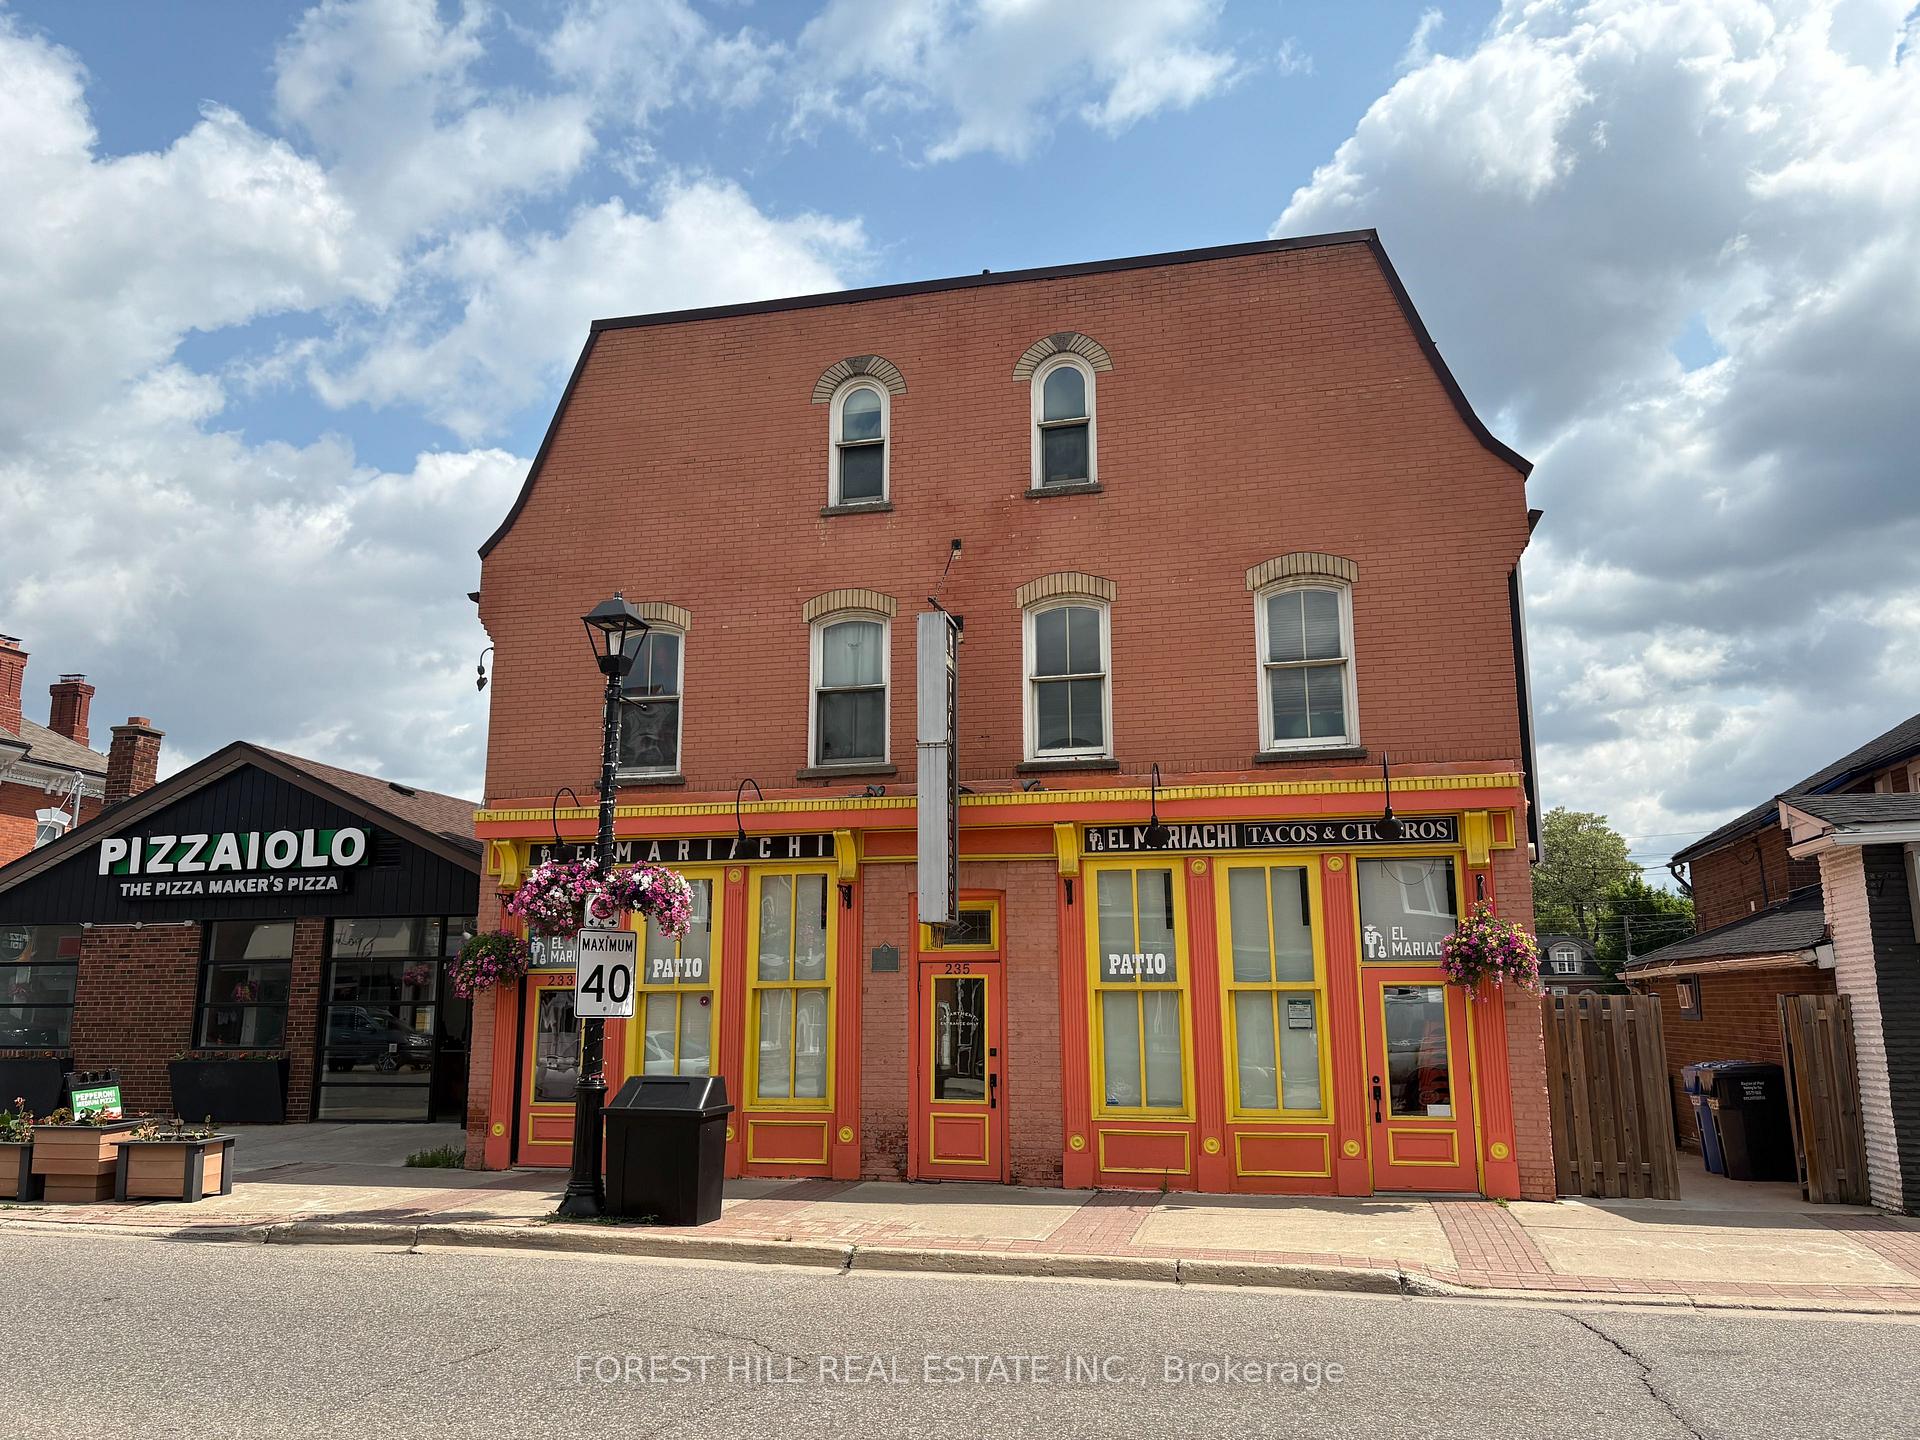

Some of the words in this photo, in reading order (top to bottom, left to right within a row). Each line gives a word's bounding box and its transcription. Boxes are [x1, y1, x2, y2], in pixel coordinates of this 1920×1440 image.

[1108, 828, 1130, 849] EL
[1133, 825, 1237, 849] MRIACHI
[1247, 825, 1317, 843] TACOS
[1323, 826, 1336, 840] &
[1341, 820, 1449, 841] CHROS
[98, 827, 366, 876] PIZZAIOLO
[120, 882, 151, 897] THE
[155, 881, 203, 896] PIZZA
[208, 875, 284, 894] MAKER'S
[288, 876, 338, 892] PIZZA
[1391, 926, 1407, 940] EL
[551, 937, 563, 949] EL
[582, 937, 633, 952] MAXIMUM
[1391, 941, 1442, 956] MARIAC
[550, 951, 577, 963] MARI
[1108, 953, 1166, 975] PATIO
[652, 958, 703, 978] PATIO
[945, 963, 970, 975] 235
[548, 975, 574, 986] 233
[581, 964, 631, 1003] 40
